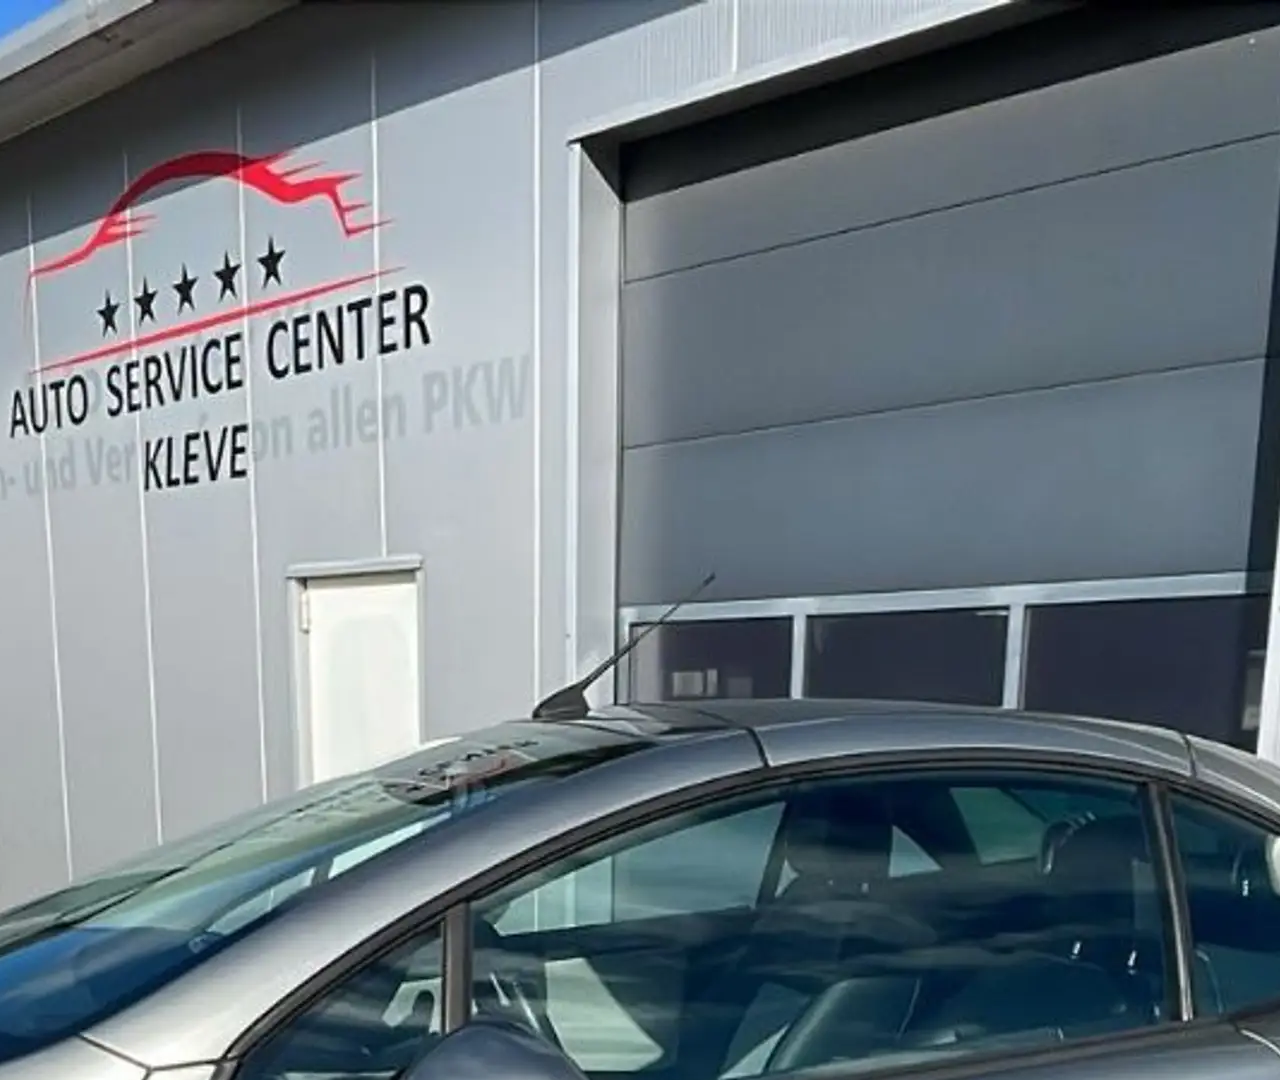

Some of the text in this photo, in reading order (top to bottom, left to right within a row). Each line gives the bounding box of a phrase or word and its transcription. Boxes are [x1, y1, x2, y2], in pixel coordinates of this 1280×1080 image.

[9, 283, 431, 439] AUTO SERVICE CENTER
[306, 385, 406, 455] allen
[421, 353, 532, 435] PKW
[144, 424, 249, 492] KLEVE
